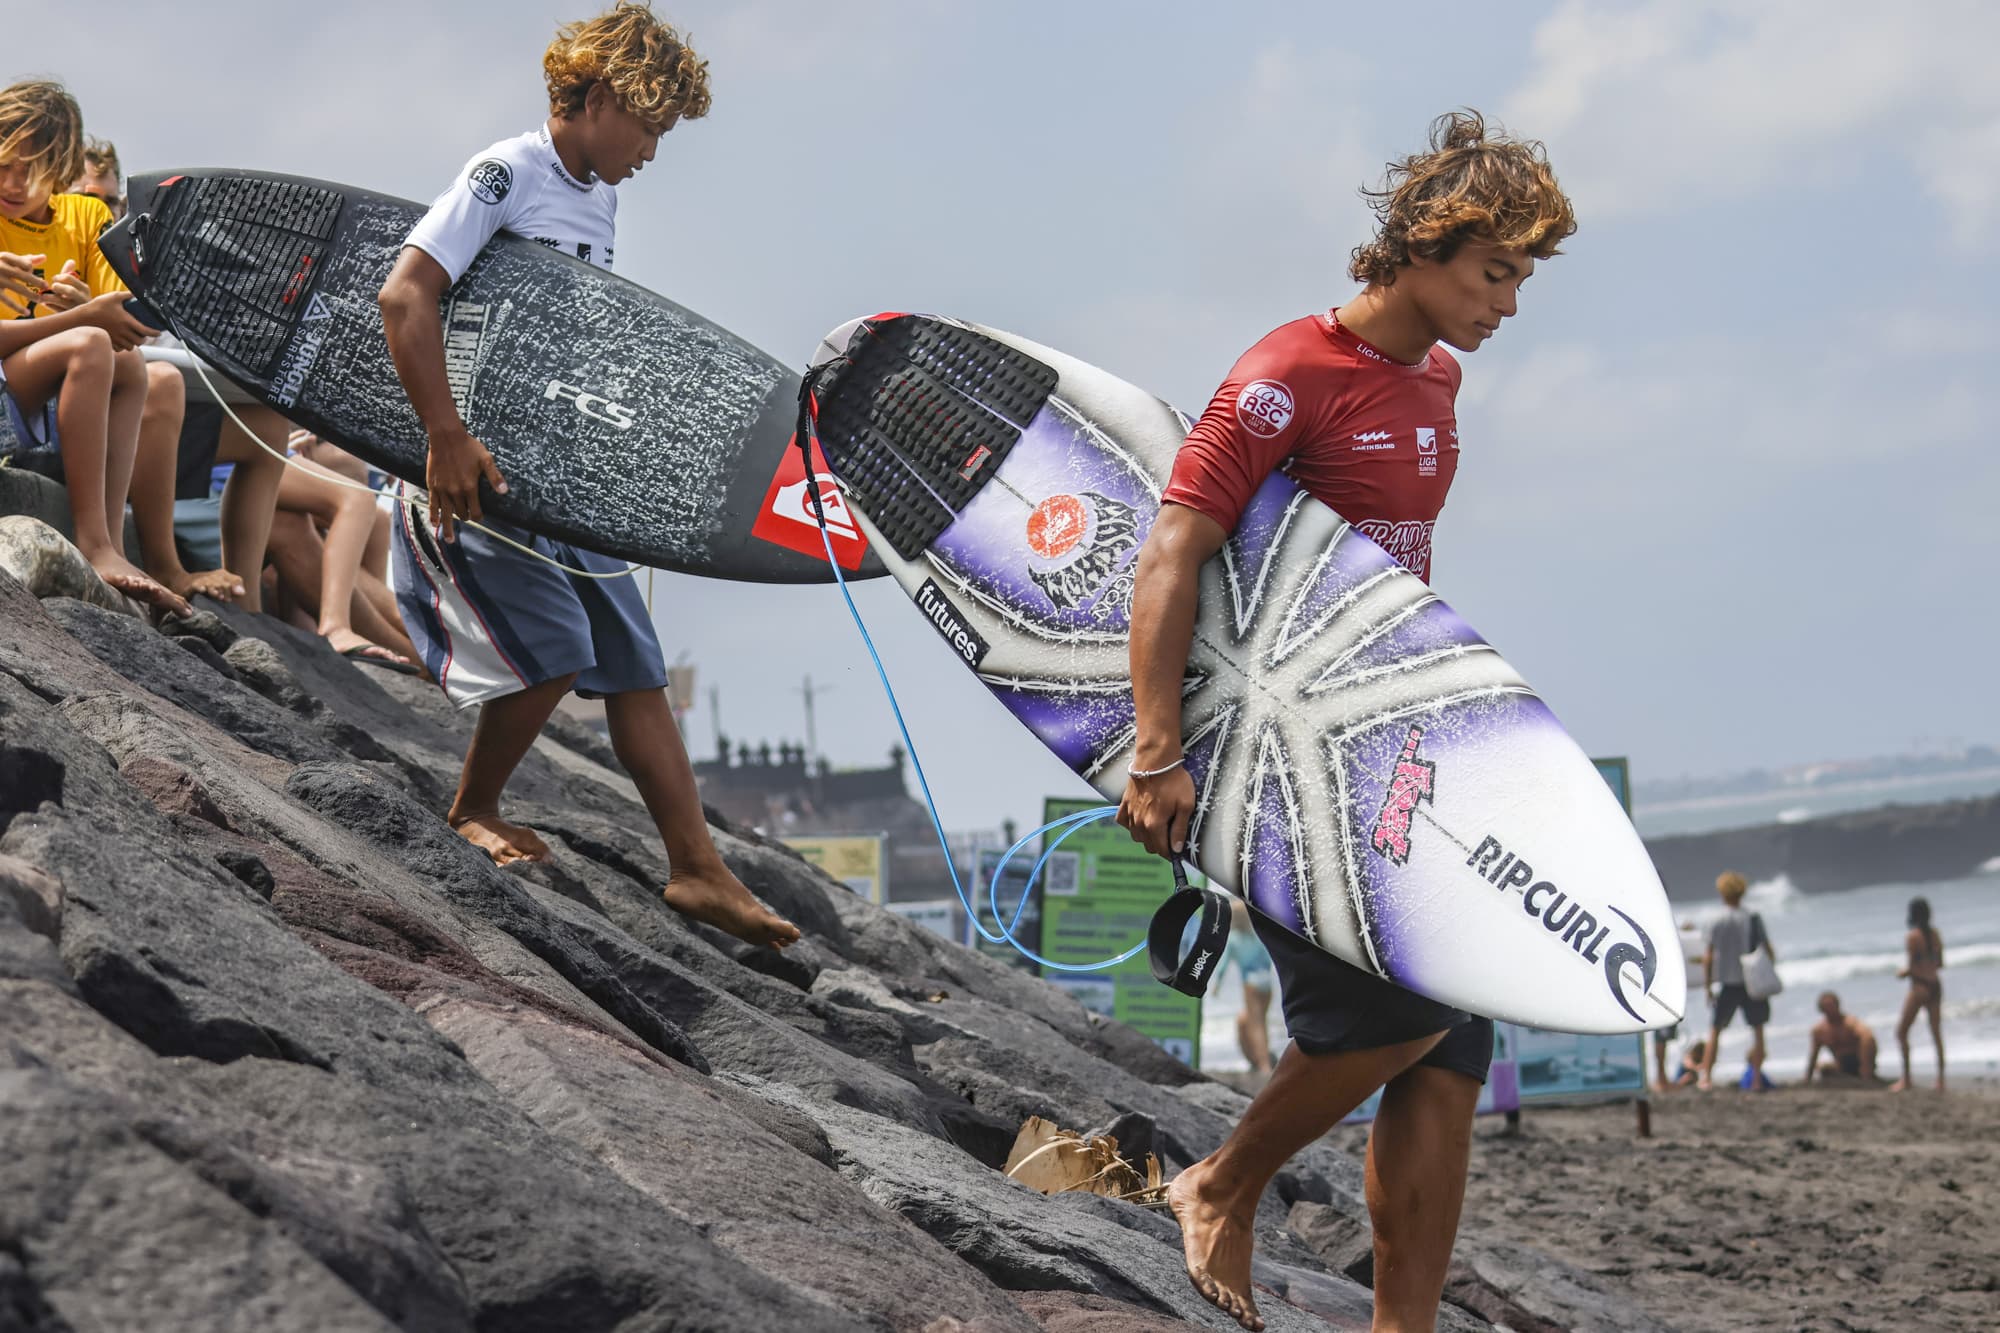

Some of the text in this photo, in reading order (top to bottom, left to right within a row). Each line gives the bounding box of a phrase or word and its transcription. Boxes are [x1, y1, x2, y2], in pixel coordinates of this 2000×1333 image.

[472, 169, 503, 195] ASC
[279, 331, 323, 408] JUNGLE
[1356, 343, 1381, 361] LIGA
[543, 379, 637, 429] FCS
[1243, 396, 1283, 423] ASC
[1418, 457, 1437, 467] LIGA
[1092, 560, 1137, 620] AGON
[920, 585, 978, 666] futures.
